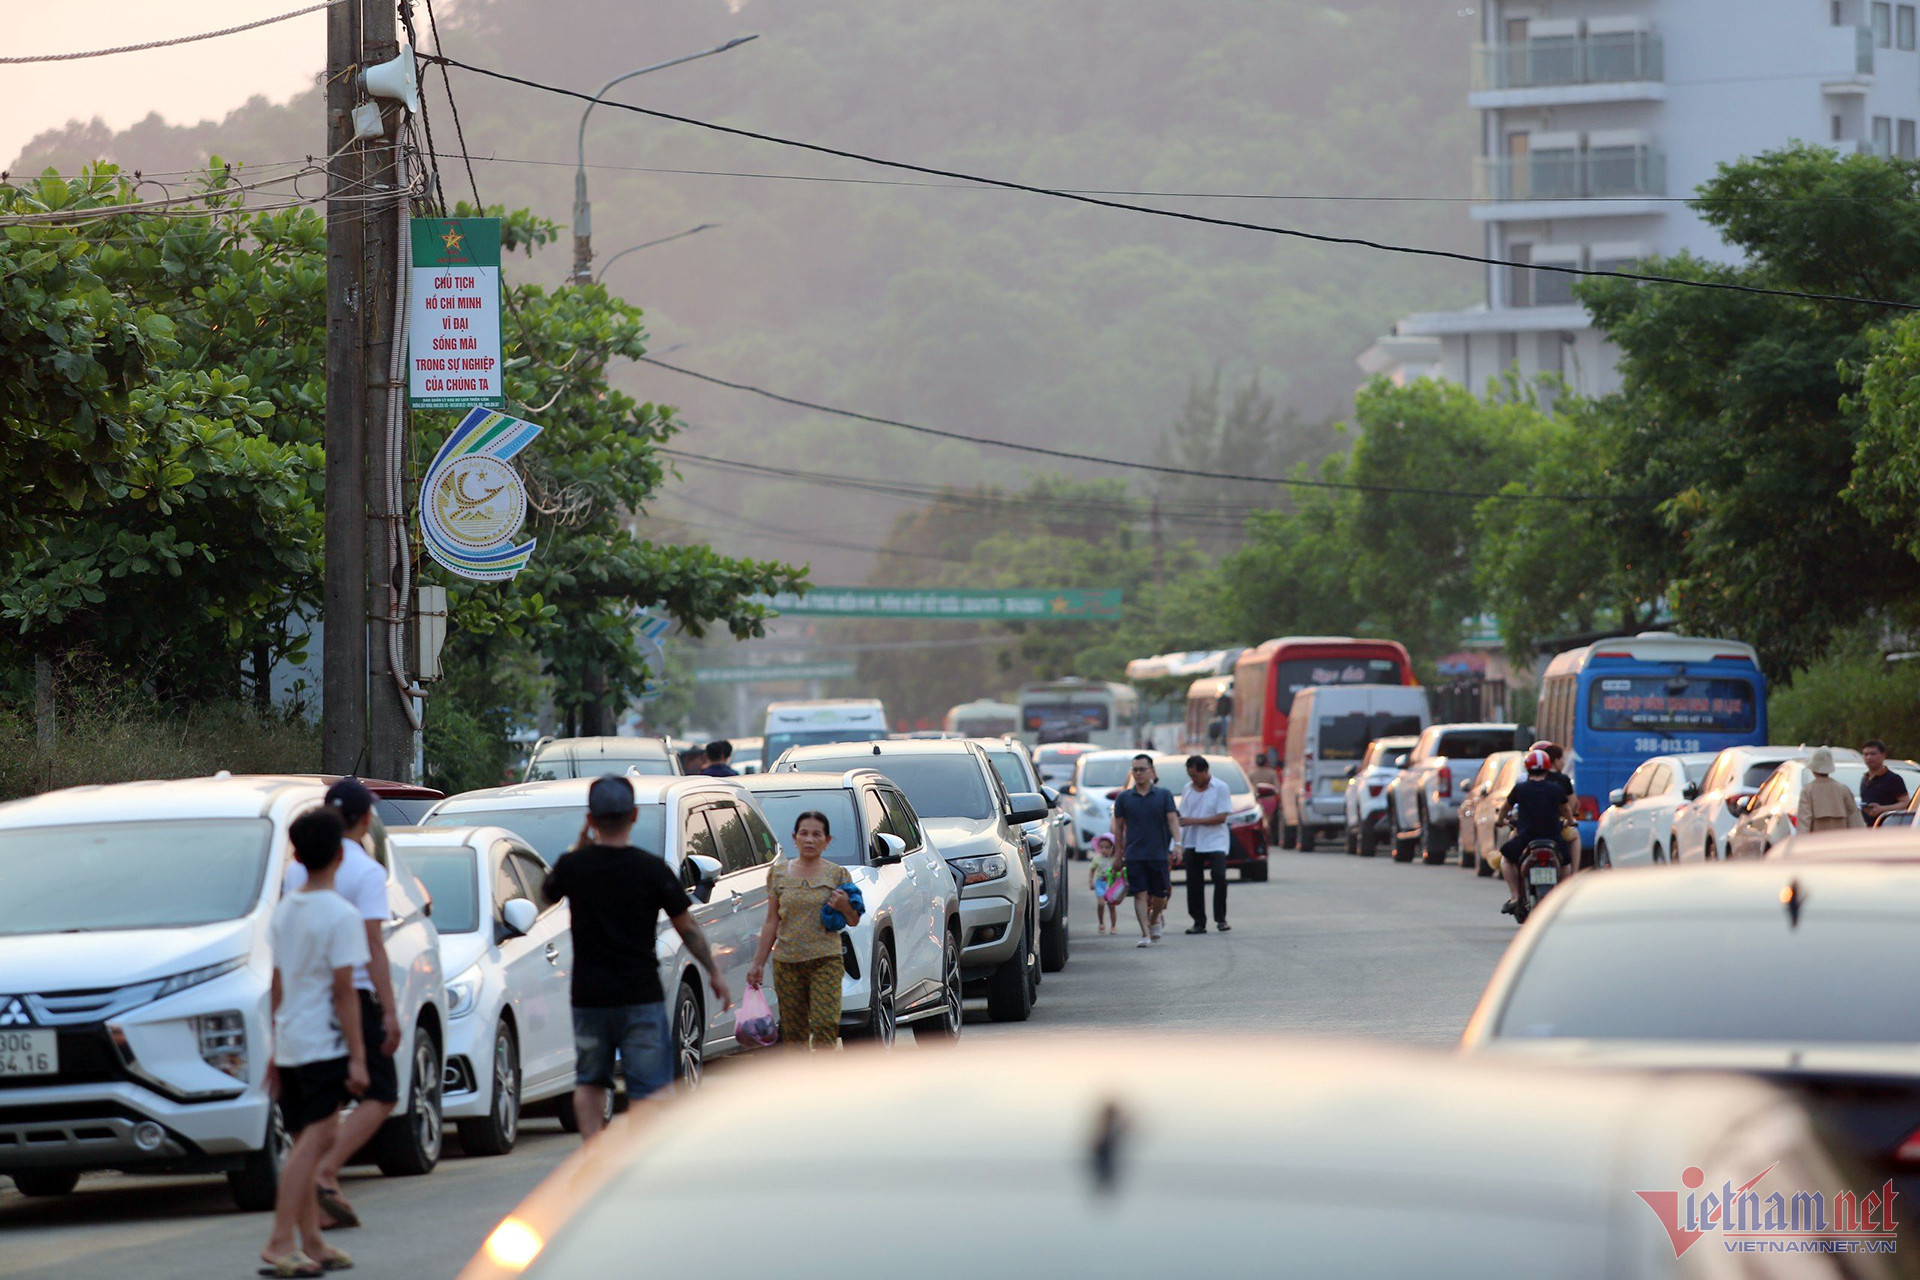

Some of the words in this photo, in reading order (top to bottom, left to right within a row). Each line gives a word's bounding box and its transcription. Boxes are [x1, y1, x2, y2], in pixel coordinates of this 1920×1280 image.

[434, 273, 452, 289] CHỦ
[455, 277, 475, 291] TỊCH
[425, 293, 438, 309] HỒ
[440, 295, 455, 309] CHÍ
[458, 297, 482, 309] MINH
[442, 315, 451, 330] VĨ
[453, 317, 469, 332] ĐẠI
[433, 334, 457, 350] SỐNG
[460, 336, 477, 350] MÃI
[416, 358, 445, 371] TRONG
[447, 357, 461, 373] SỰ
[462, 355, 495, 373] NGHIỆP
[426, 375, 444, 391] CỦA
[446, 376, 477, 391] CHÚNG
[478, 378, 489, 391] TA
